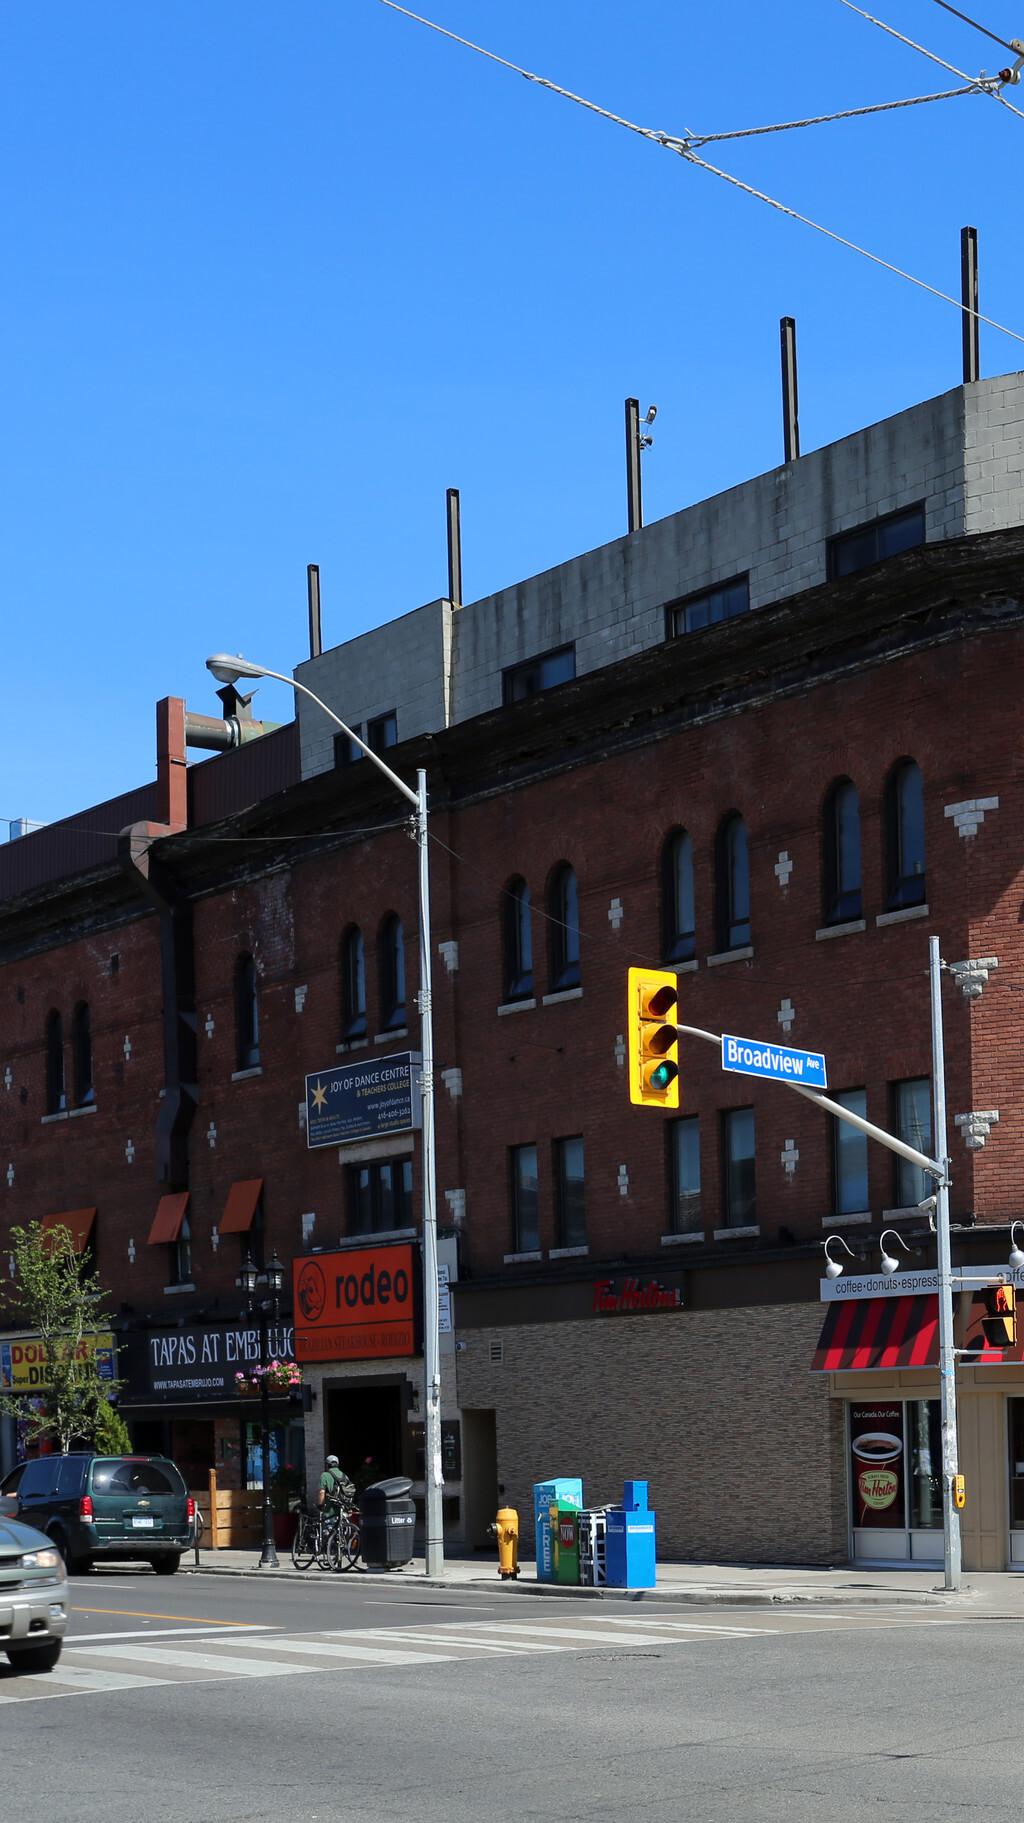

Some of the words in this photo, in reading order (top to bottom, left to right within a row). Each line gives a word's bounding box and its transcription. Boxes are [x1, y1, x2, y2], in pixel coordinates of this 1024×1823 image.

[728, 1040, 803, 1075] Broadview
[806, 1057, 820, 1069] Ave
[330, 1081, 342, 1093] JOY
[343, 1078, 354, 1090] OF
[355, 1072, 379, 1087] DANCE
[380, 1065, 409, 1081] CENTRE
[361, 1085, 387, 1096] TEACHERS
[387, 1079, 410, 1091] COLLEGE
[336, 1262, 408, 1308] rodeo
[592, 1280, 620, 1312] Tim
[620, 1277, 681, 1309] Hortons
[12, 1341, 89, 1364] DOLAR
[151, 1335, 196, 1366] TAPAS
[201, 1334, 220, 1363] AT
[12, 1375, 30, 1385] Super
[153, 1378, 224, 1389] WWW.TAPASATEMBRUJO.COM
[391, 1516, 406, 1524] Litter
[560, 1526, 574, 1542] NOW
[542, 1522, 551, 1572] FREE
